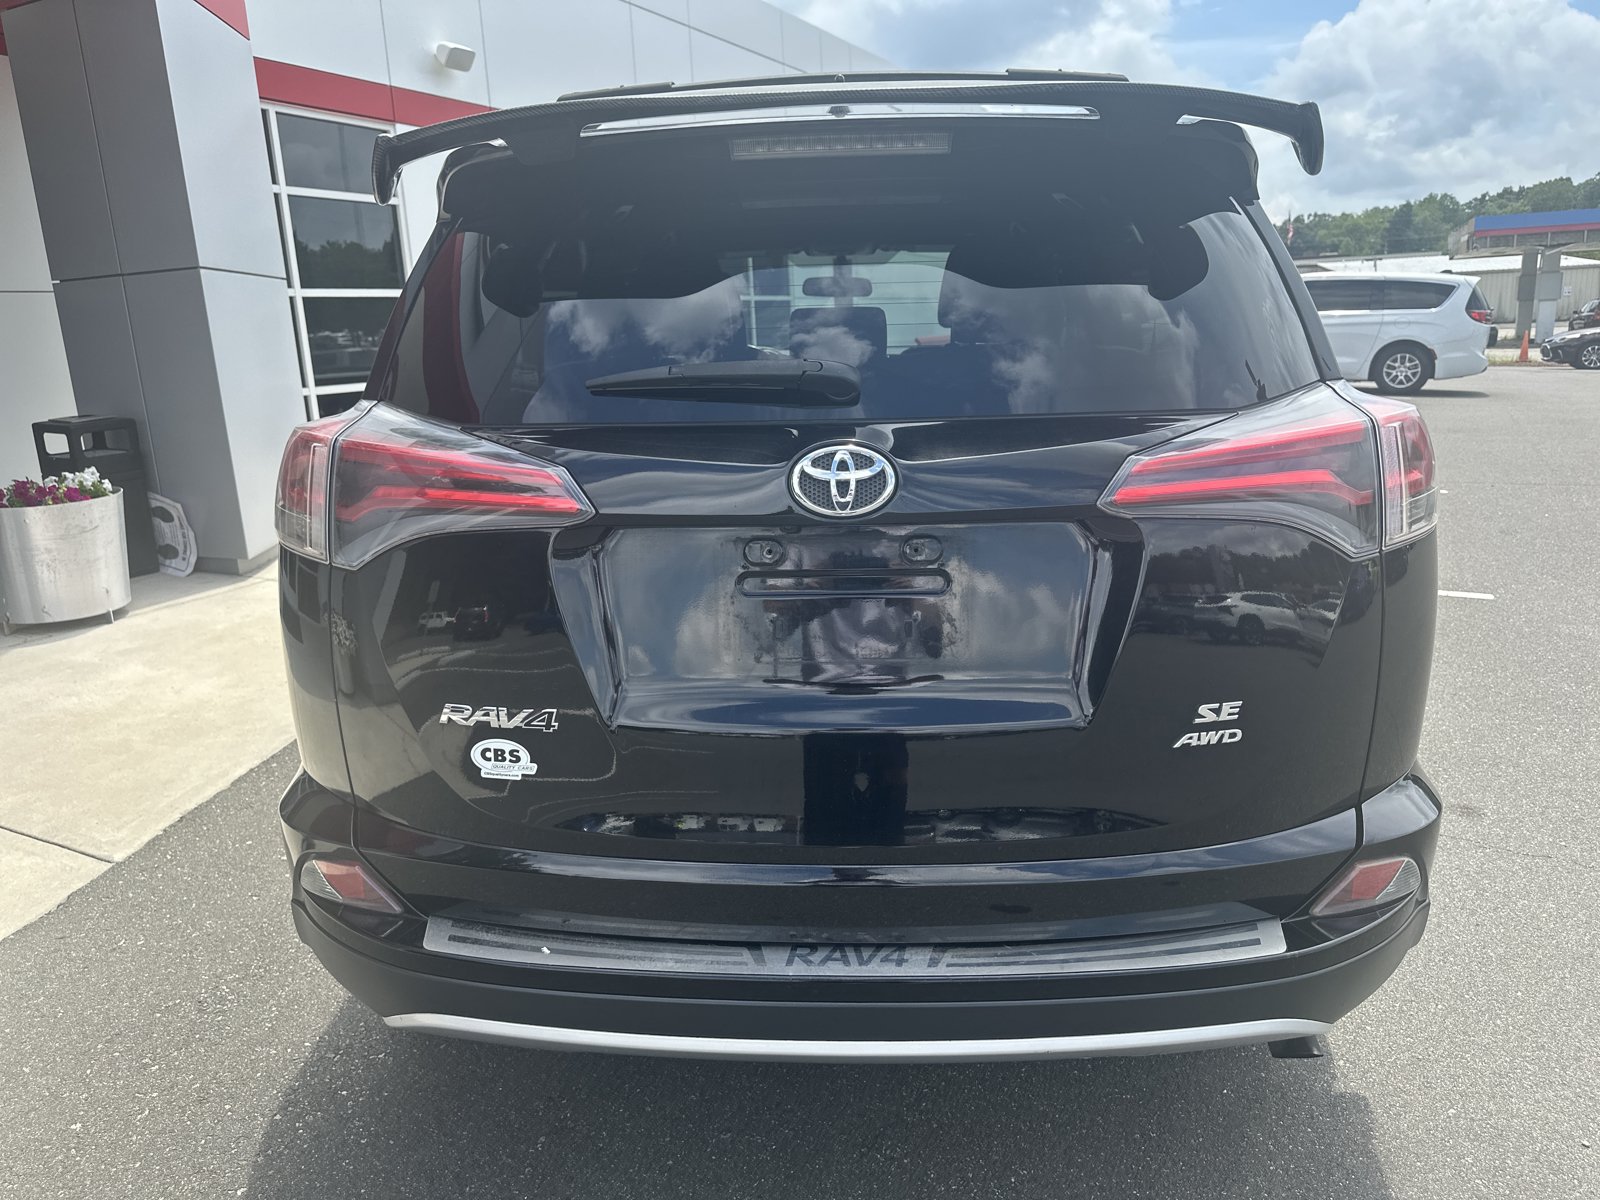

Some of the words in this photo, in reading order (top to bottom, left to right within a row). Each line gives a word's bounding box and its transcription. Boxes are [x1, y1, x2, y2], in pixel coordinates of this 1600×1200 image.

[439, 703, 559, 732] RAV4
[1193, 701, 1243, 724] SE
[1173, 729, 1243, 748] AWD
[480, 747, 522, 764] CBS
[785, 943, 909, 967] RAV4
